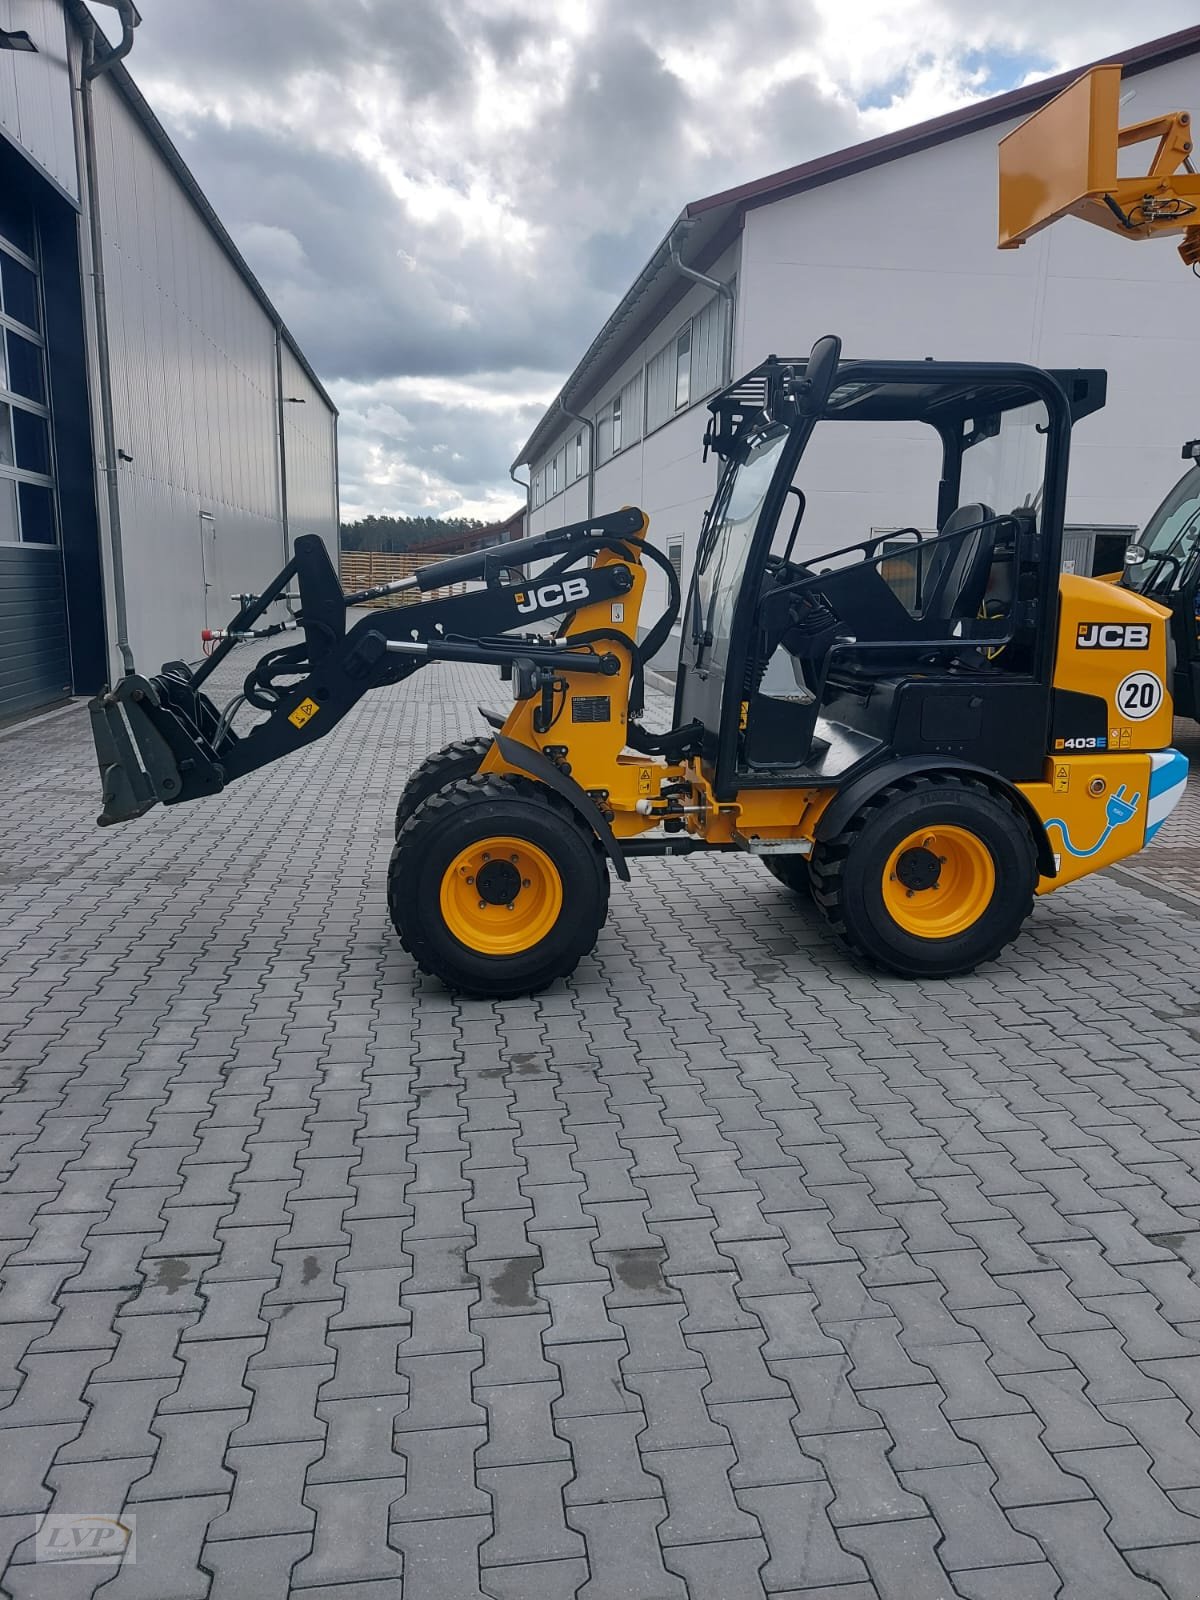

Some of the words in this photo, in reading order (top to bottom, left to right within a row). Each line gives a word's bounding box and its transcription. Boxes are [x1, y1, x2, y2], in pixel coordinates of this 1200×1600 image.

[517, 578, 590, 614] JCB
[1077, 625, 1149, 648] JCB
[1124, 683, 1154, 708] 20
[1064, 737, 1107, 749] 403E
